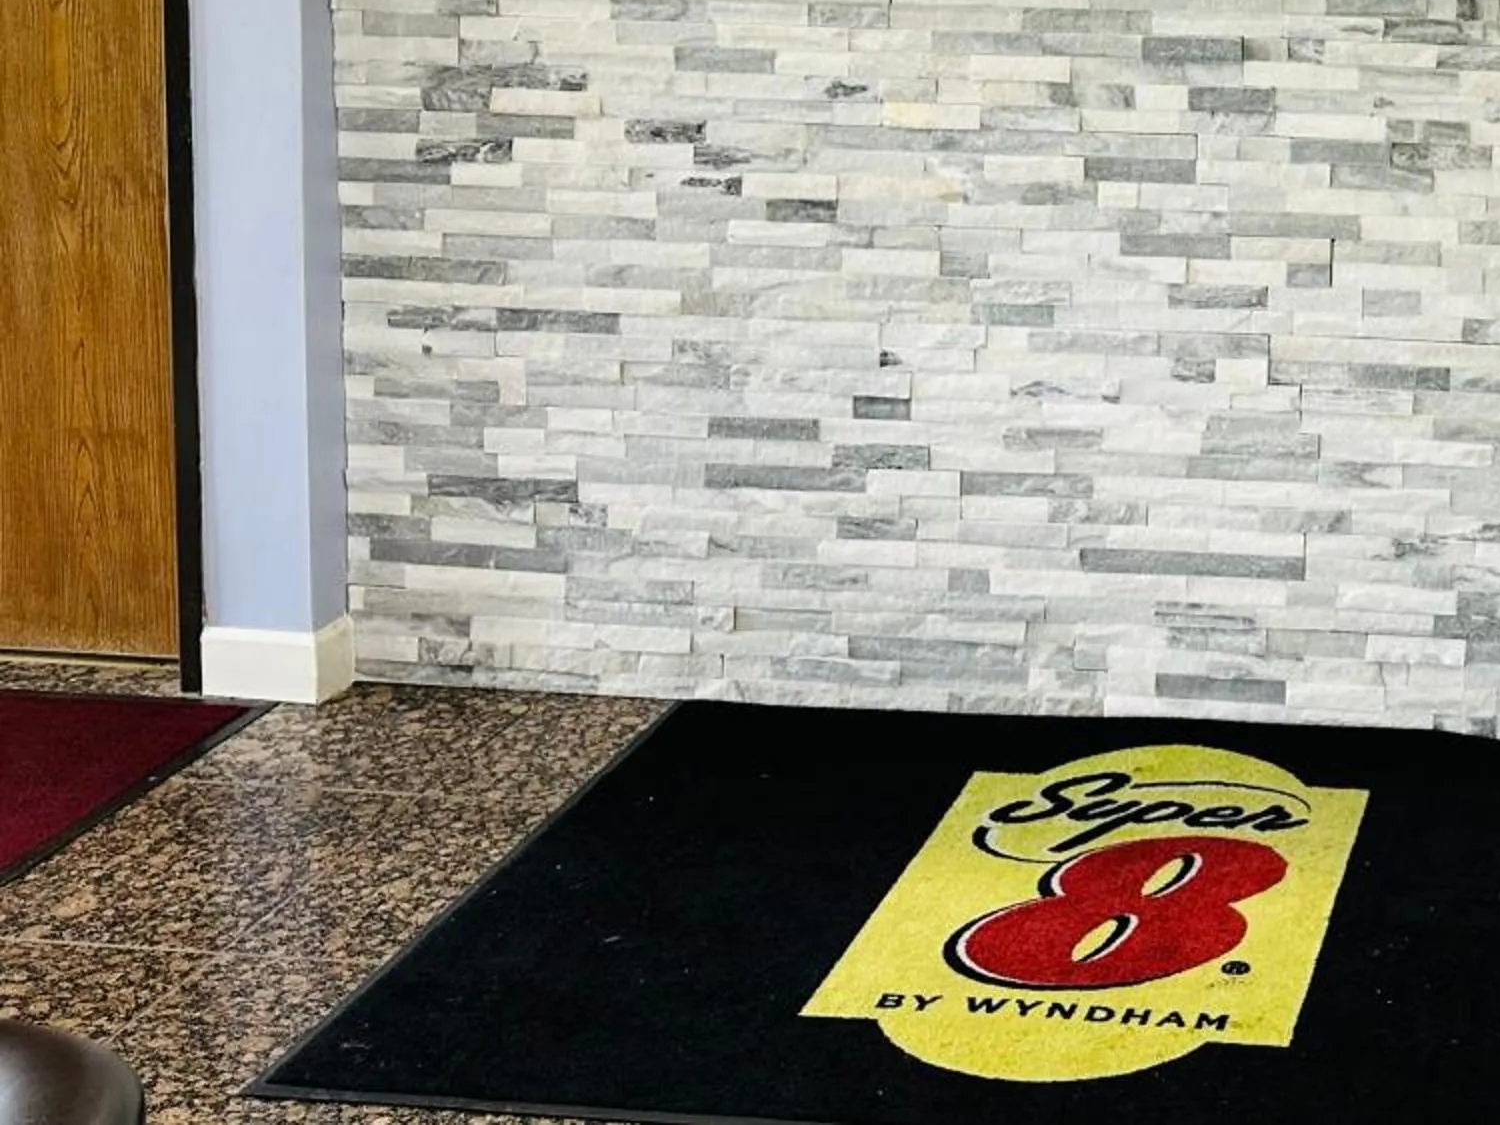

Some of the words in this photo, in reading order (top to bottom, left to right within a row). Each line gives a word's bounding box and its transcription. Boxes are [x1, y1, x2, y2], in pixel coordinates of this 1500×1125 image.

[988, 771, 1308, 855] Super
[942, 835, 1289, 991] 8
[874, 992, 943, 1011] BY
[965, 996, 1231, 1031] WYNDHAM
